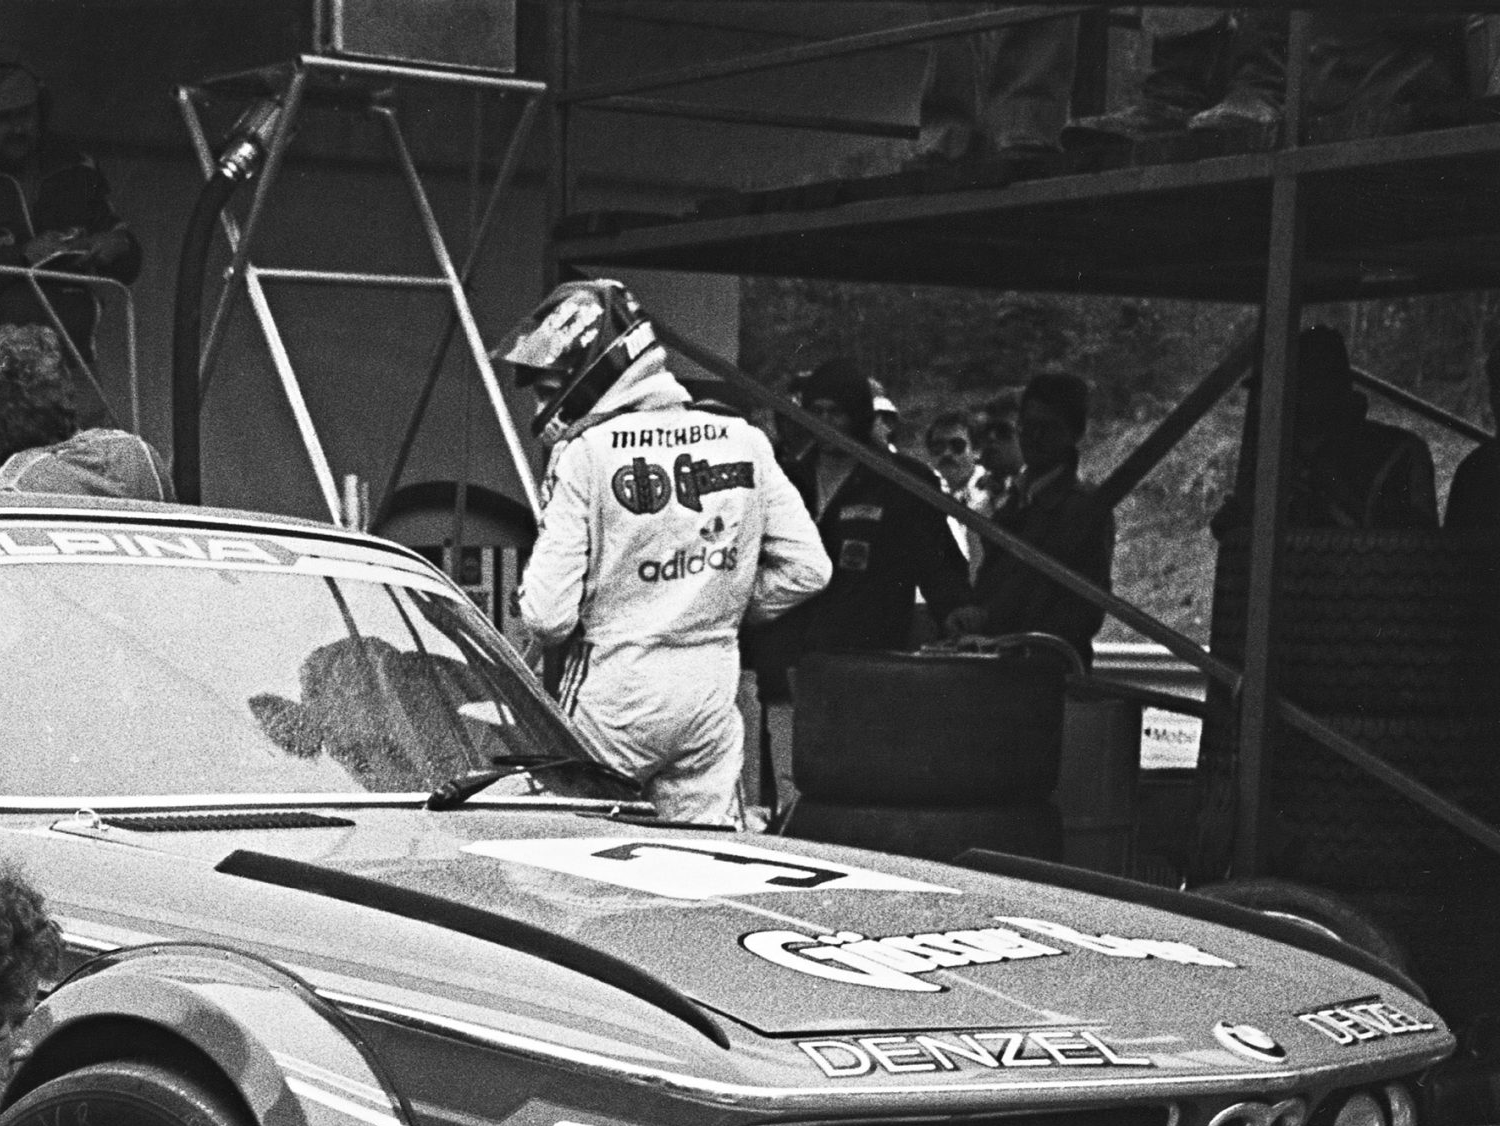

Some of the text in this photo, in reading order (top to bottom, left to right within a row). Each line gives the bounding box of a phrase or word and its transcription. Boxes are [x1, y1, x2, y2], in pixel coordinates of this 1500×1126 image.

[611, 423, 730, 449] MATCHBOX
[637, 546, 738, 583] adidas
[1298, 1002, 1435, 1046] DENZEL
[798, 1030, 1152, 1078] DENZEL
